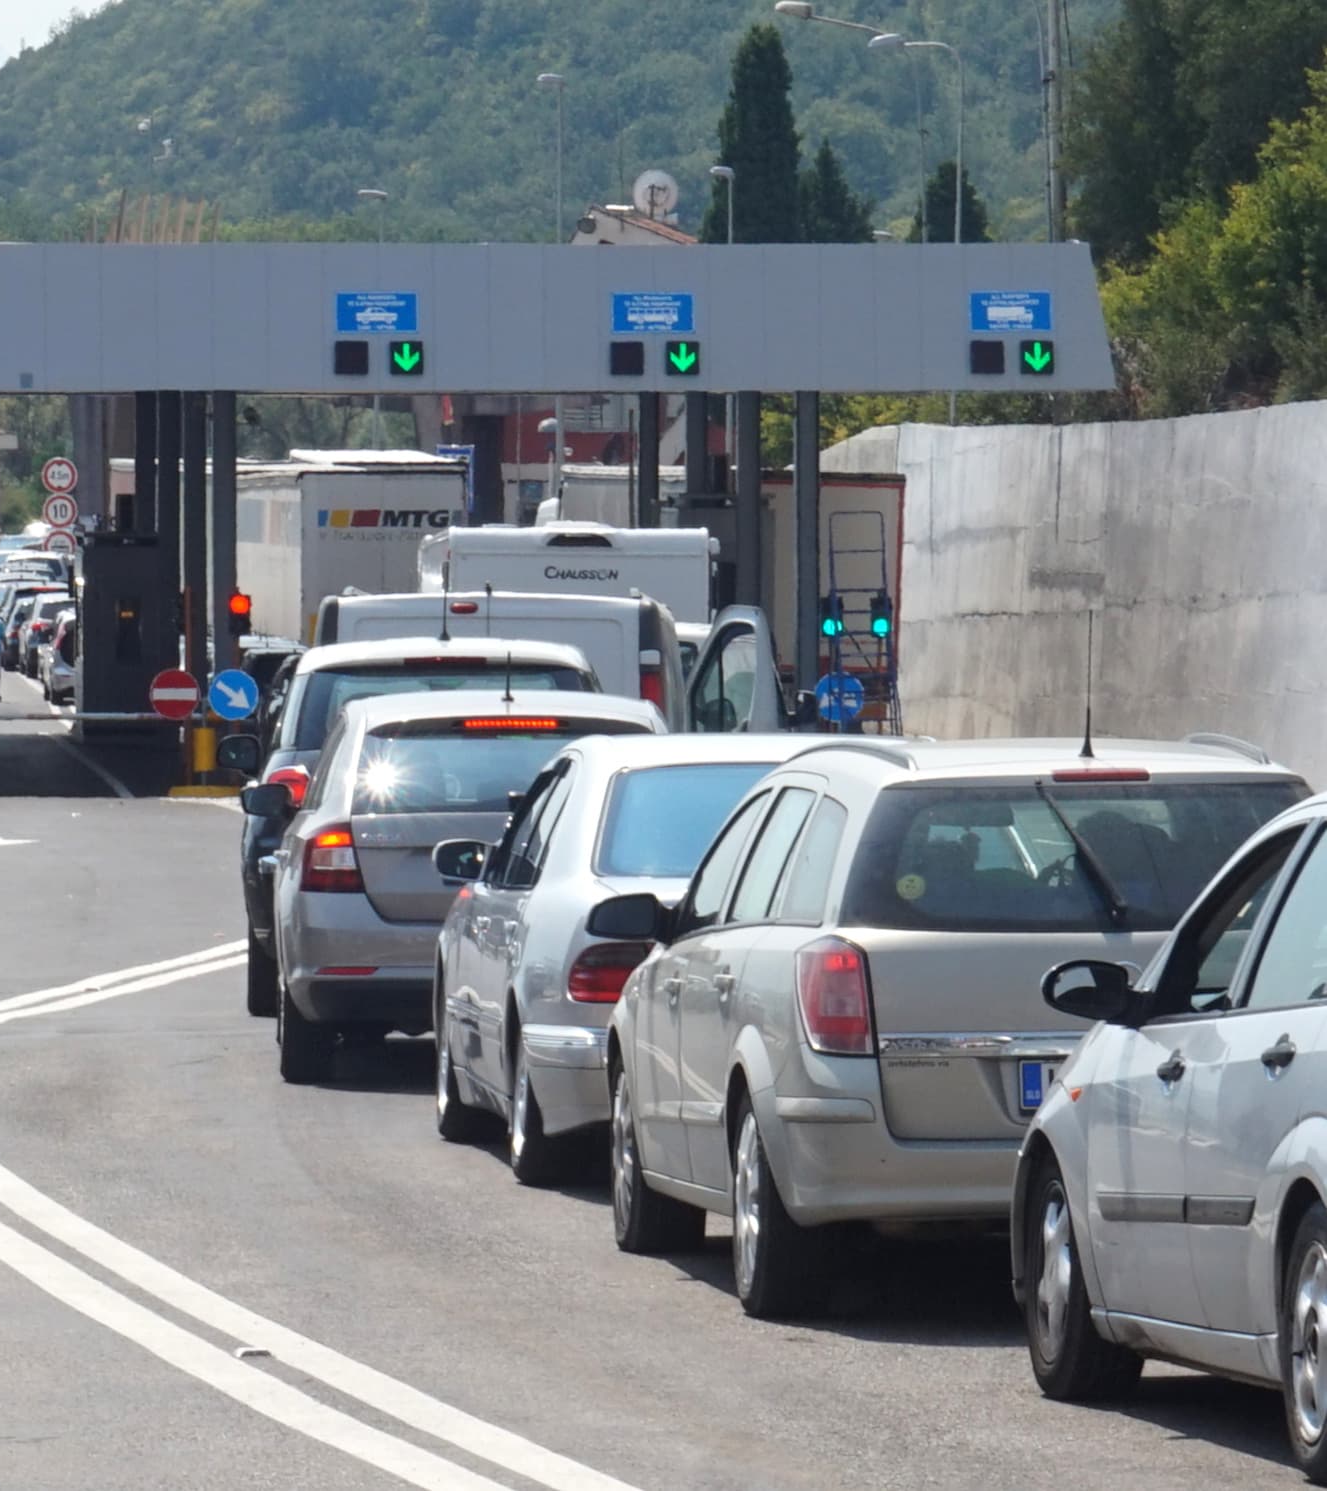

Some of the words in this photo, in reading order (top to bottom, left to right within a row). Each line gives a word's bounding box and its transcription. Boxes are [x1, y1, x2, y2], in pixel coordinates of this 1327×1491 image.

[53, 503, 68, 519] 10
[382, 510, 450, 528] MTG
[544, 565, 619, 581] CHAUSSON
